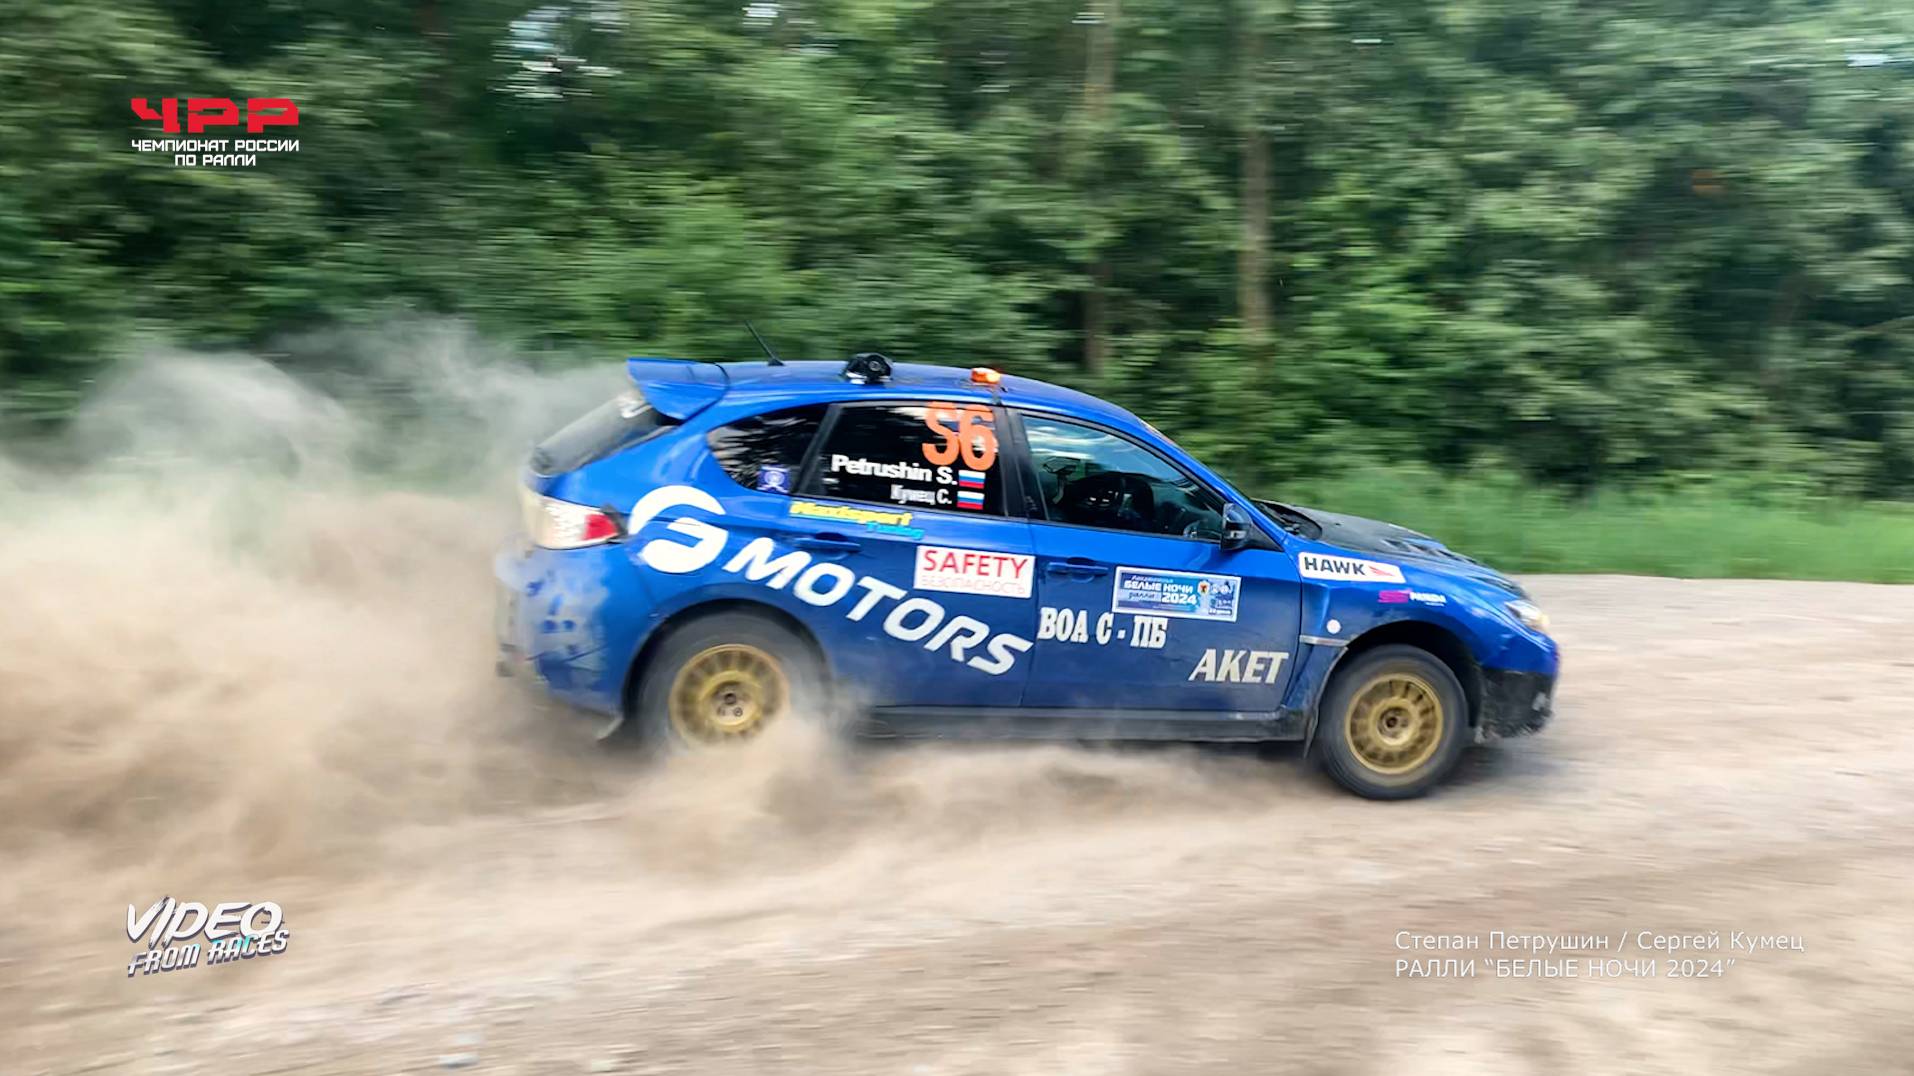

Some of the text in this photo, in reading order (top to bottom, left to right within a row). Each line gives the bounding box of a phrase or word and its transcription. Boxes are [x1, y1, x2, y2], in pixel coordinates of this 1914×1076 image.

[921, 401, 997, 471] S6
[831, 454, 958, 486] Petrushin S.
[923, 549, 1029, 579] SAFETY
[1304, 556, 1366, 576] HAWK
[1123, 580, 1194, 594] БЕЛЫЕ НОЧИ
[1161, 592, 1198, 605] 2024
[723, 536, 1033, 676] MOTORS
[1130, 615, 1168, 649] ПБ
